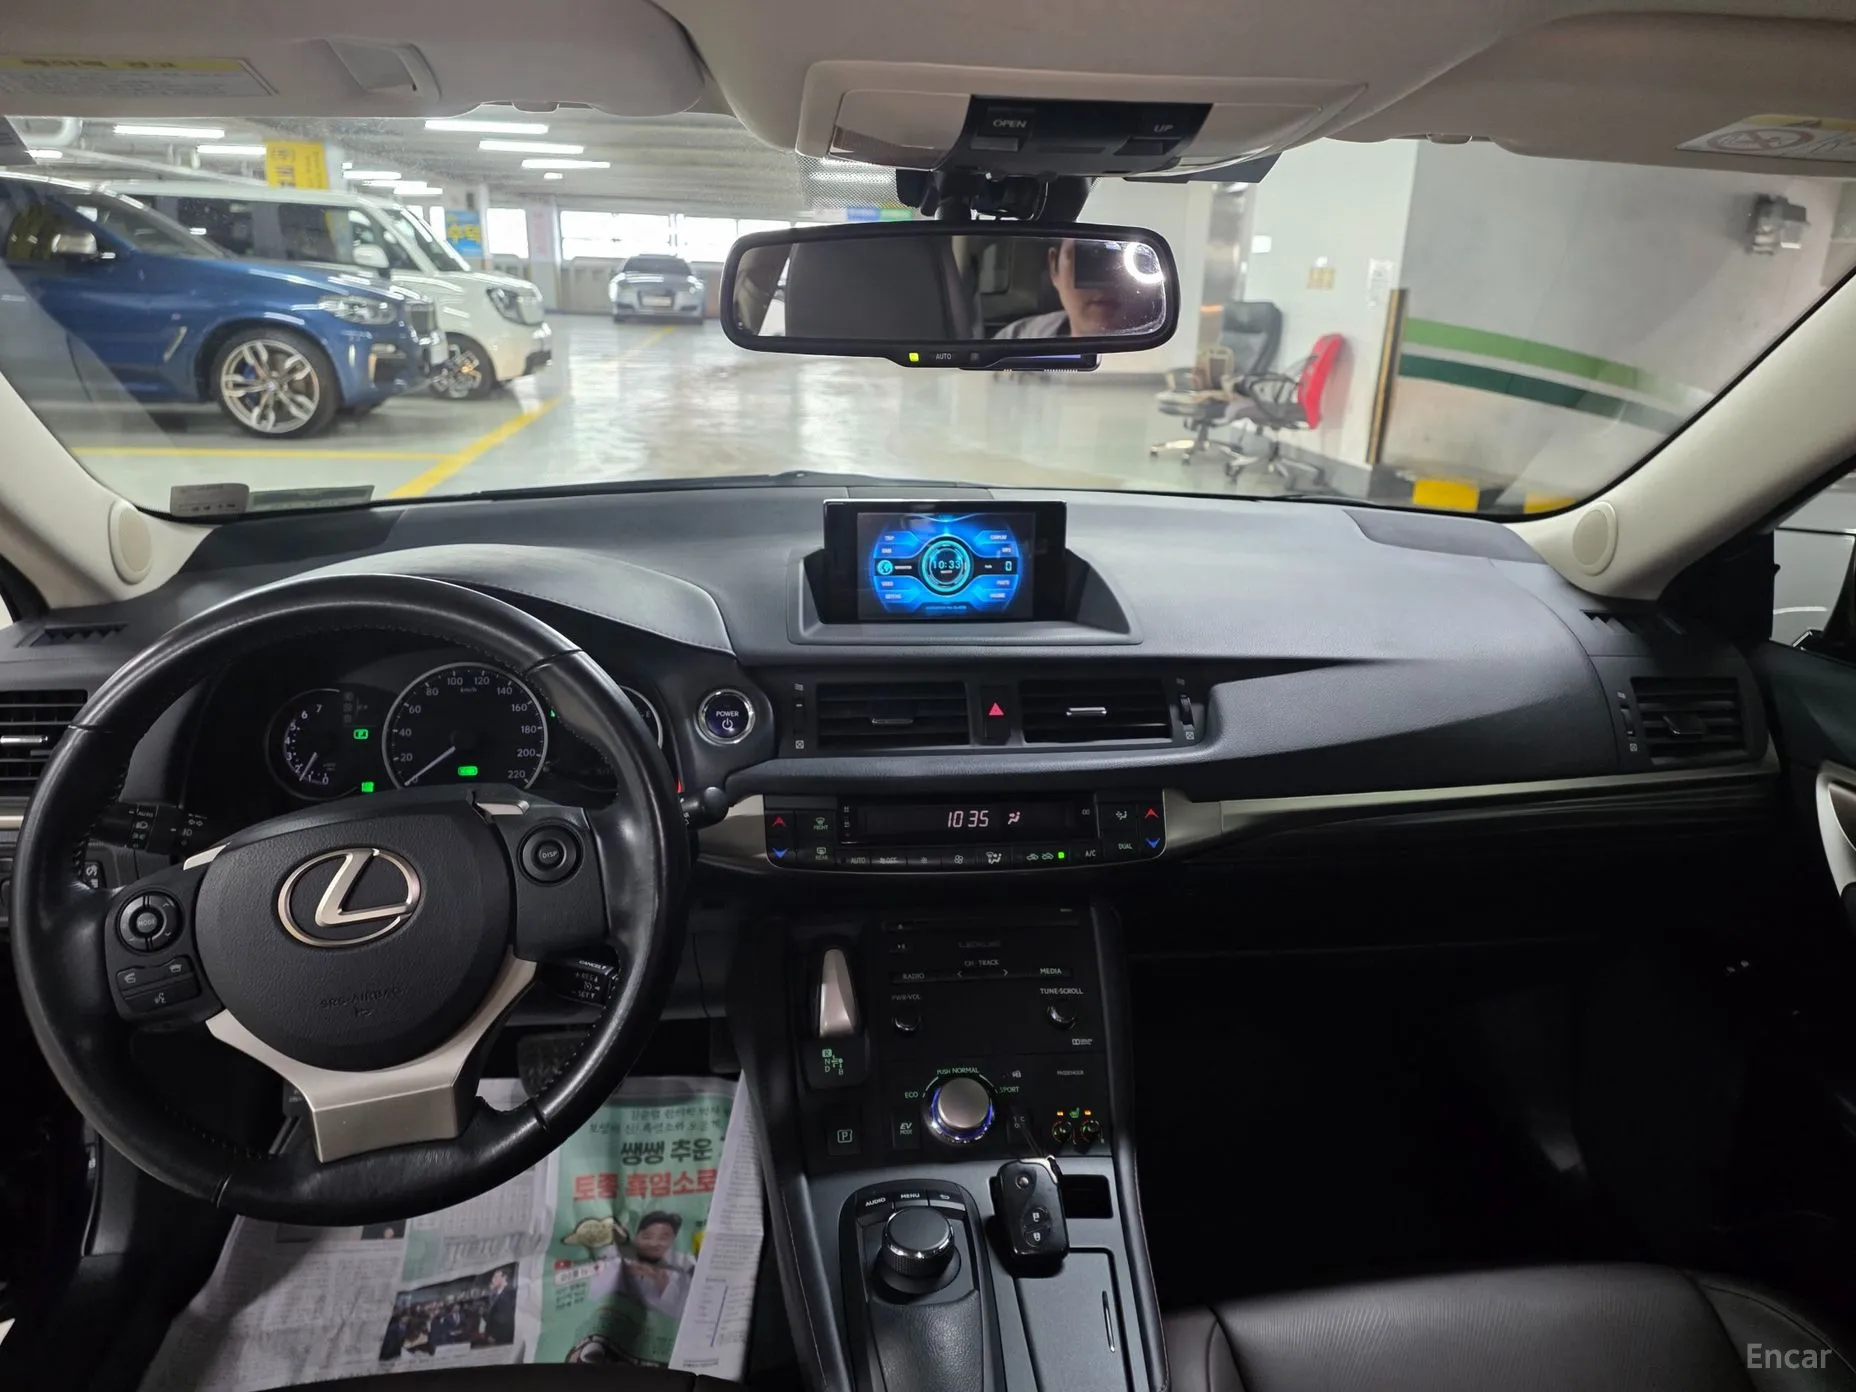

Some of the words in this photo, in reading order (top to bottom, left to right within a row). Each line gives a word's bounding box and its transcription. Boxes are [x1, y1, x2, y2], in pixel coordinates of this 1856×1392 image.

[992, 119, 1028, 128] OPEN
[1153, 124, 1174, 132] UP
[935, 353, 952, 361] AUTO
[447, 676, 463, 686] 100
[474, 675, 490, 686] 120
[426, 688, 439, 697] 80
[496, 686, 513, 695] 140
[316, 704, 322, 713] 7
[409, 704, 422, 714] 60
[511, 702, 528, 713] 160
[301, 710, 308, 720] 6
[715, 710, 740, 718] POWER
[399, 728, 412, 737] 40
[521, 725, 537, 735] 180
[284, 736, 291, 745] 4
[286, 752, 293, 761] 3
[400, 753, 413, 762] 20
[517, 748, 536, 758] 200
[507, 770, 525, 780] 220
[1118, 843, 1133, 851] DUAL
[541, 850, 559, 859] DISP
[1084, 850, 1097, 858] A/C
[850, 857, 867, 865] AUTO
[1039, 967, 1063, 976] MEDIA
[902, 972, 925, 981] RADIO
[951, 1066, 980, 1075] NORMAL
[999, 1085, 1020, 1094] SPORT
[904, 1091, 919, 1099] ECO
[900, 1121, 913, 1130] EV
[621, 1140, 665, 1165] 쌩쌩
[670, 1138, 713, 1162] 추운
[574, 1172, 618, 1202] 토종
[865, 1197, 887, 1207] AUDIO
